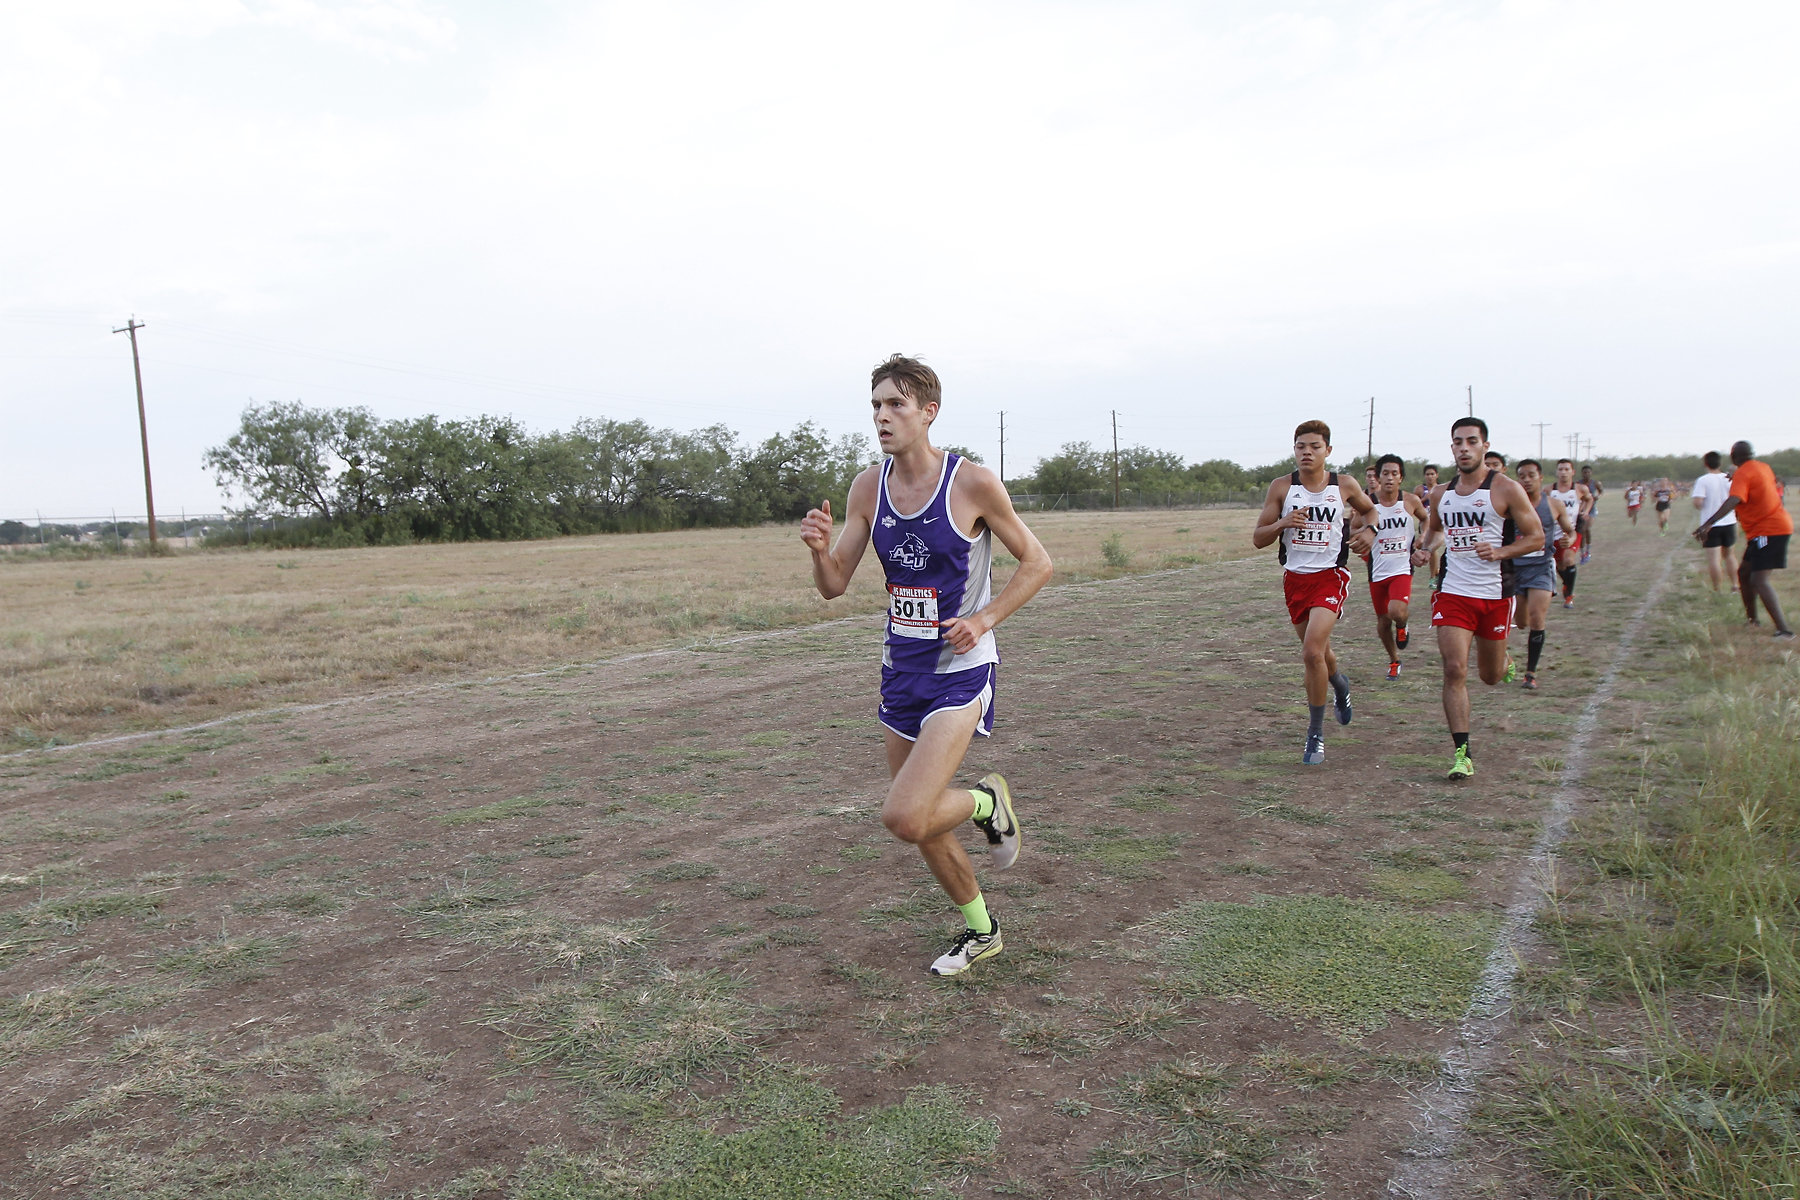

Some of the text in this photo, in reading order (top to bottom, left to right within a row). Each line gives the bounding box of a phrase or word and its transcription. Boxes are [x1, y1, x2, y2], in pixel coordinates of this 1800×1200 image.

[1292, 505, 1336, 523] IW
[1443, 511, 1486, 528] UIW
[1297, 530, 1323, 541] 511
[892, 546, 926, 569] ACU
[899, 587, 933, 598] ATHLETICS
[894, 599, 926, 619] 501
